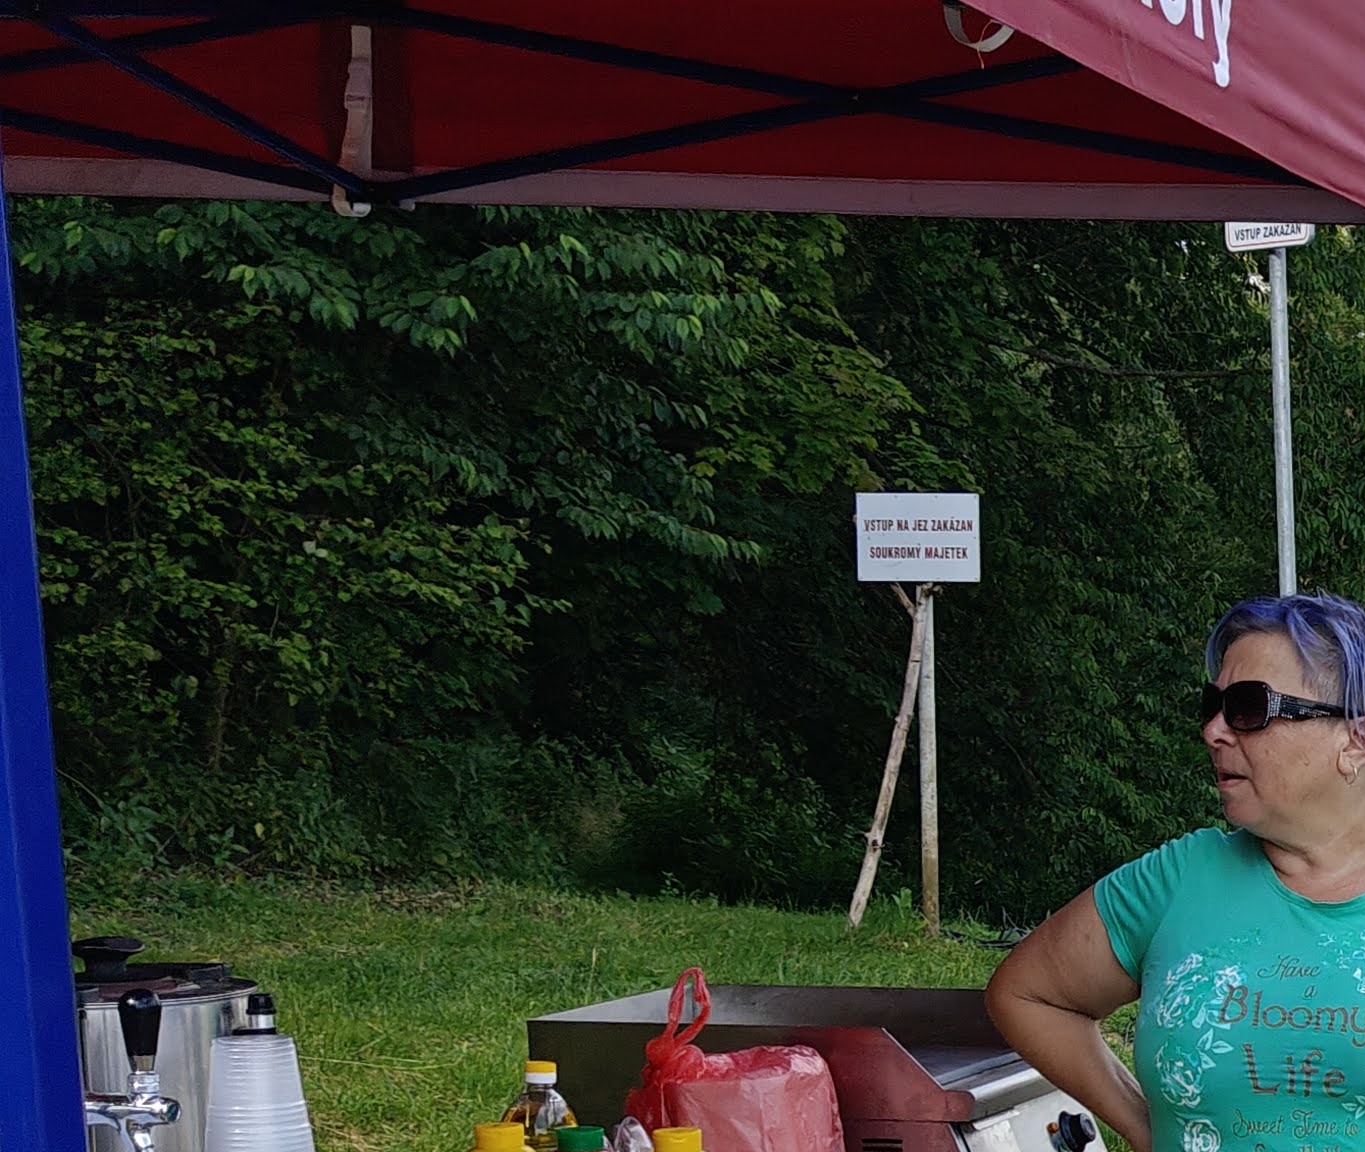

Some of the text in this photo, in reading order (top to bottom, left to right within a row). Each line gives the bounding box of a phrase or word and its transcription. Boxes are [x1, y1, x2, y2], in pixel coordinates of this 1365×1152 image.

[1234, 227, 1261, 241] VSTUP
[863, 519, 894, 532] VSTUP
[896, 519, 909, 532] NA
[912, 519, 929, 532] JEZ
[924, 546, 968, 559] MAJETEK
[1256, 954, 1321, 981] Have
[1303, 984, 1318, 998] a
[1242, 1043, 1350, 1098] Life
[1232, 1108, 1360, 1139] Sweet Time to
